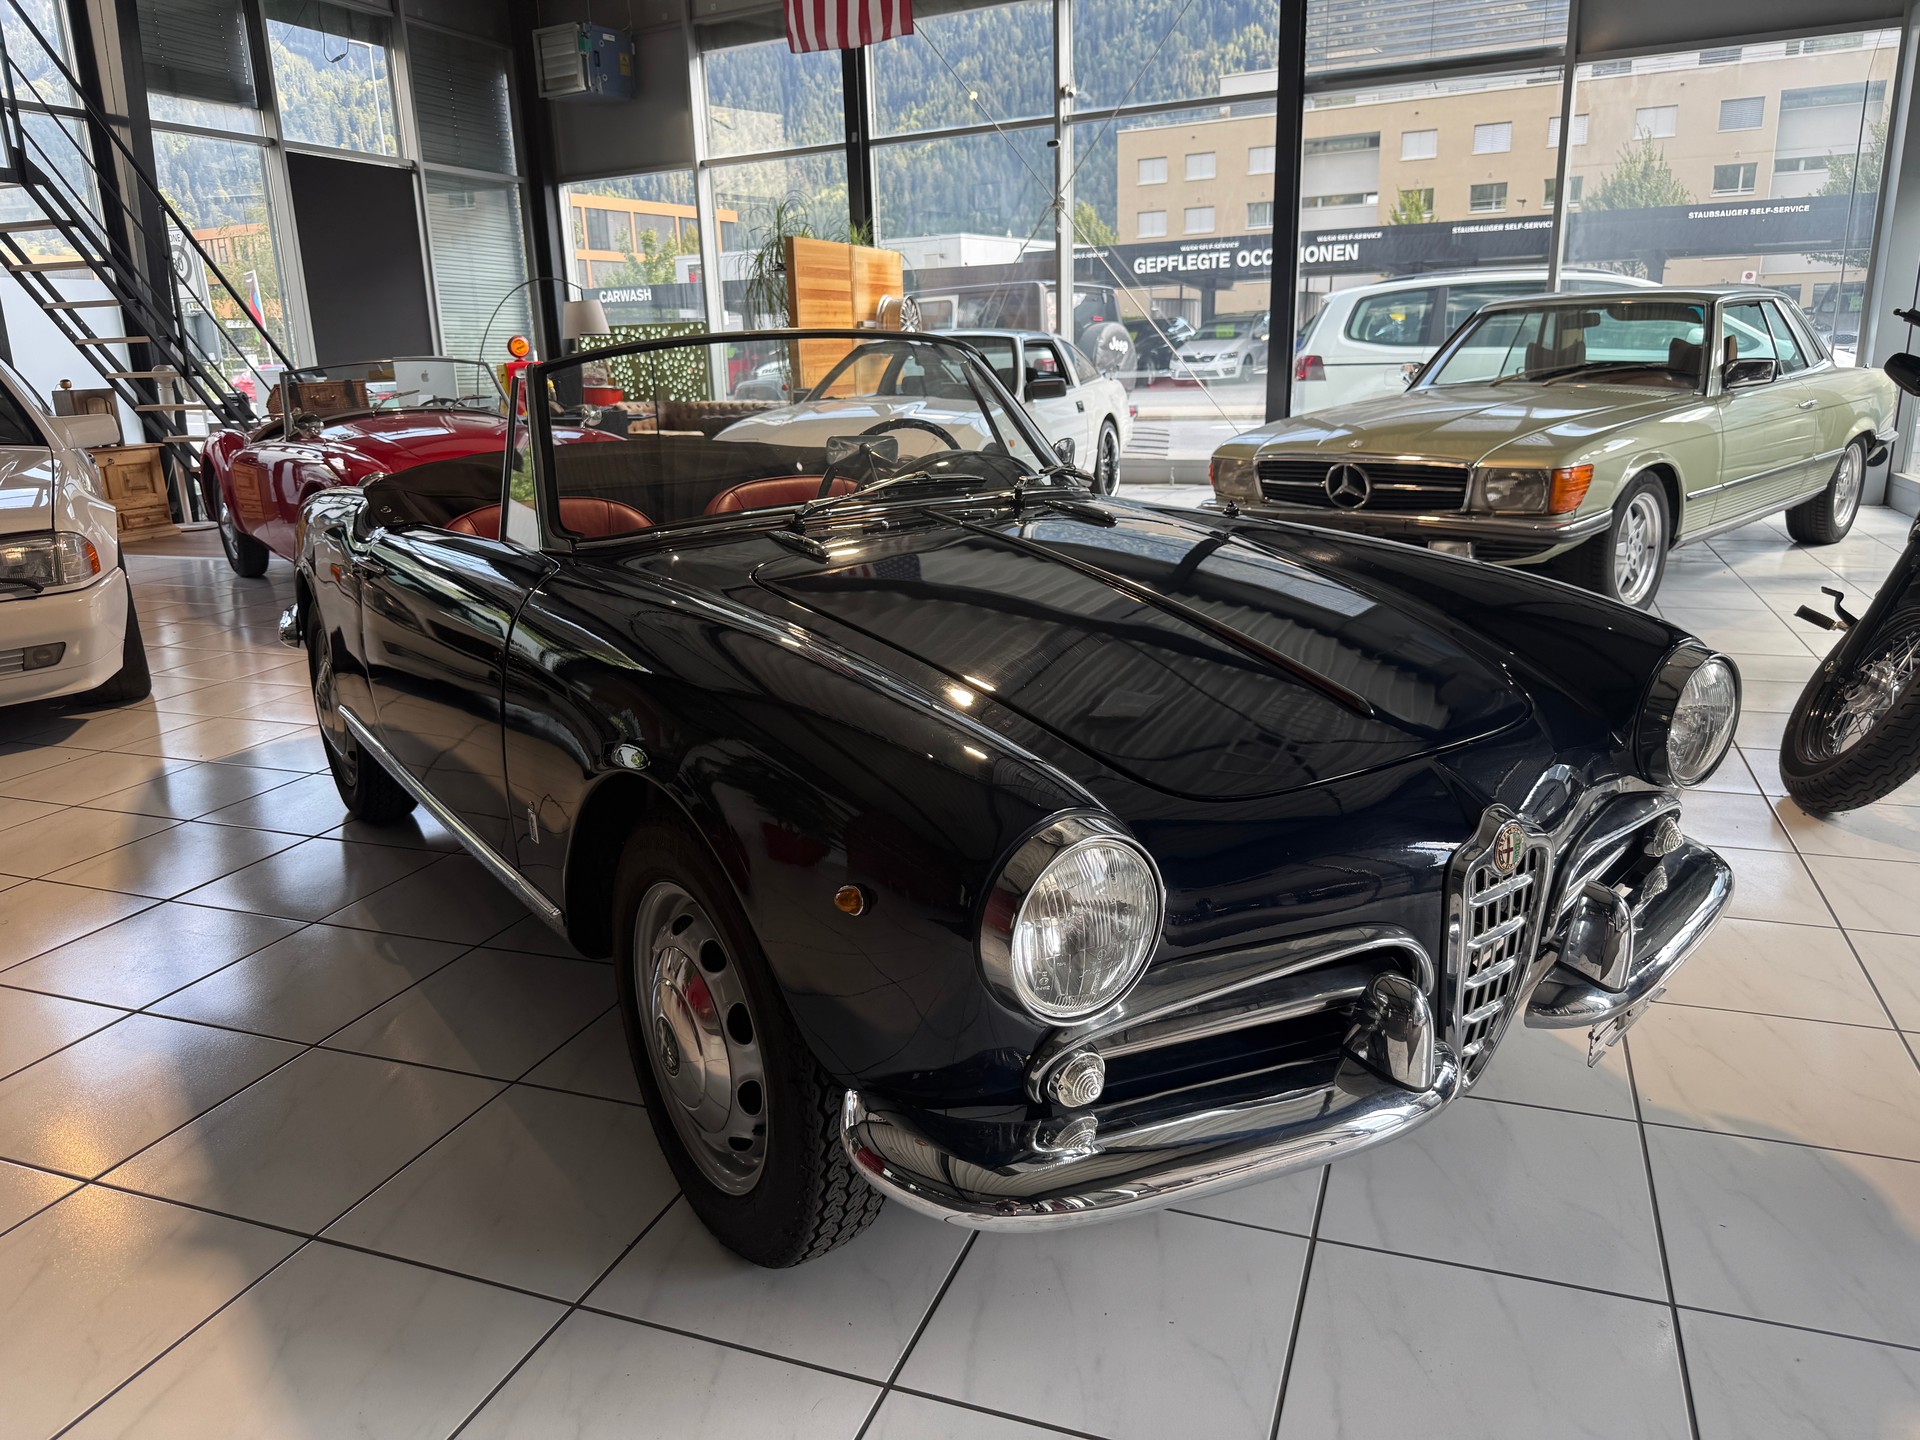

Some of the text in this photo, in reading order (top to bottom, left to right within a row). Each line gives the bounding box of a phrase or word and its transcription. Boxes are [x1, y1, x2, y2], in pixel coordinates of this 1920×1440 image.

[1688, 205, 1810, 219] STAUBSAUGER SELF-SERVICE
[1452, 223, 1504, 234] STAUBSAUGER
[1133, 243, 1359, 274] GEPFLEGTE OCCIONEN
[599, 288, 652, 303] CARWASH
[1109, 336, 1128, 354] Jeep
